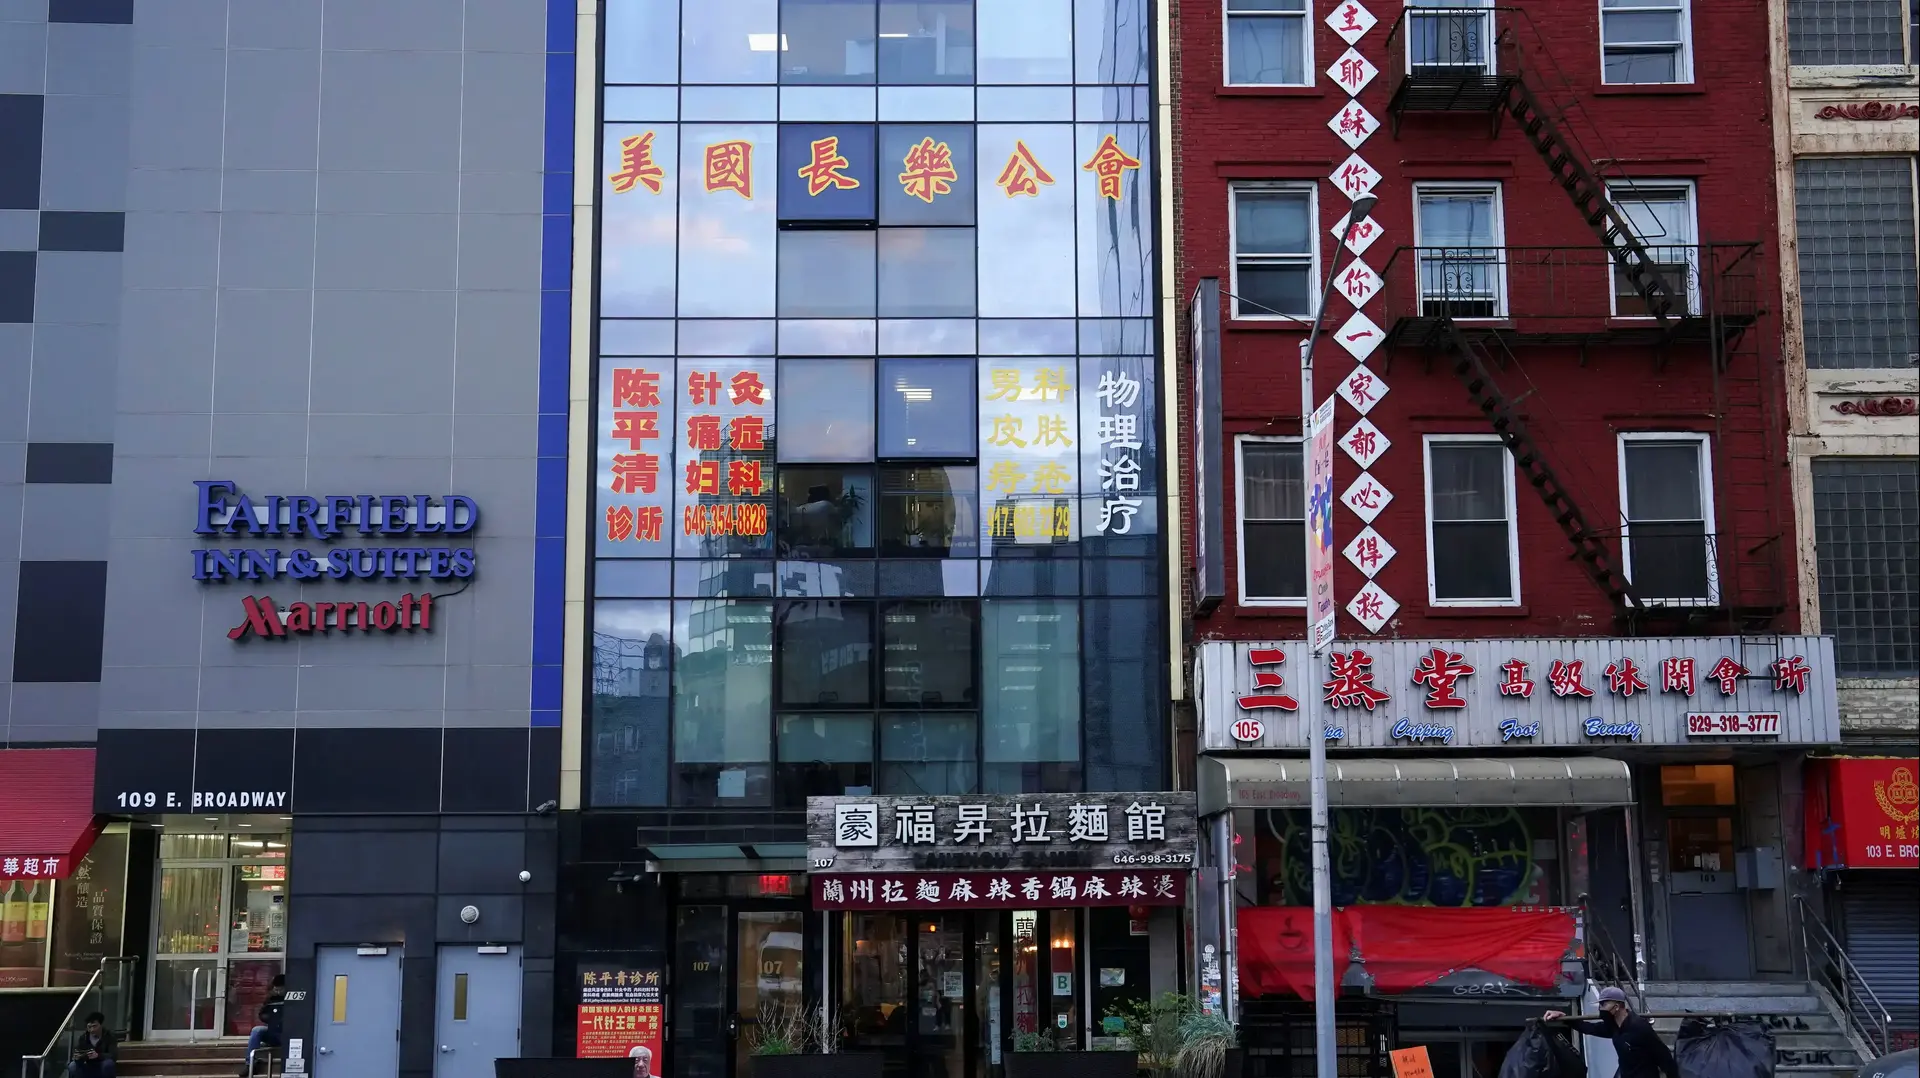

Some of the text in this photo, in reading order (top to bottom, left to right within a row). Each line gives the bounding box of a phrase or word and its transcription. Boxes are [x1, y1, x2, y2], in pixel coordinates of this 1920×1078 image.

[609, 132, 1140, 203] 美國長樂公會
[688, 371, 764, 406] 针灸
[986, 366, 1072, 403] 男科
[686, 414, 764, 450] 痛症
[986, 413, 1073, 448] 皮肤
[1096, 370, 1142, 535] 物理治疗
[685, 460, 764, 496] 妇科
[986, 459, 1072, 494] 痔疮
[192, 480, 478, 540] FAIRFIELD
[684, 503, 767, 536] 646-354-8828
[191, 548, 475, 580] INN & SUITES
[226, 592, 433, 640] Marriott
[1237, 647, 1476, 711] 三蒸堂
[1234, 720, 1260, 739] 105
[1392, 717, 1455, 744] Cupping
[1499, 716, 1540, 742] Foot
[1584, 716, 1643, 742] Beauty
[1688, 714, 1779, 734] 929-318-3777
[117, 791, 286, 808] 109 E. BROADWAY
[813, 858, 835, 868] 107
[1113, 854, 1192, 864] 646-998-3175
[1865, 845, 1882, 858] 103
[1885, 844, 1896, 858] E.
[3, 857, 60, 876] 華超市
[1700, 873, 1716, 883] 105
[692, 961, 710, 971] 107
[286, 991, 305, 1000] 109
[1057, 975, 1068, 990] B
[582, 1015, 626, 1030] 一代针王
